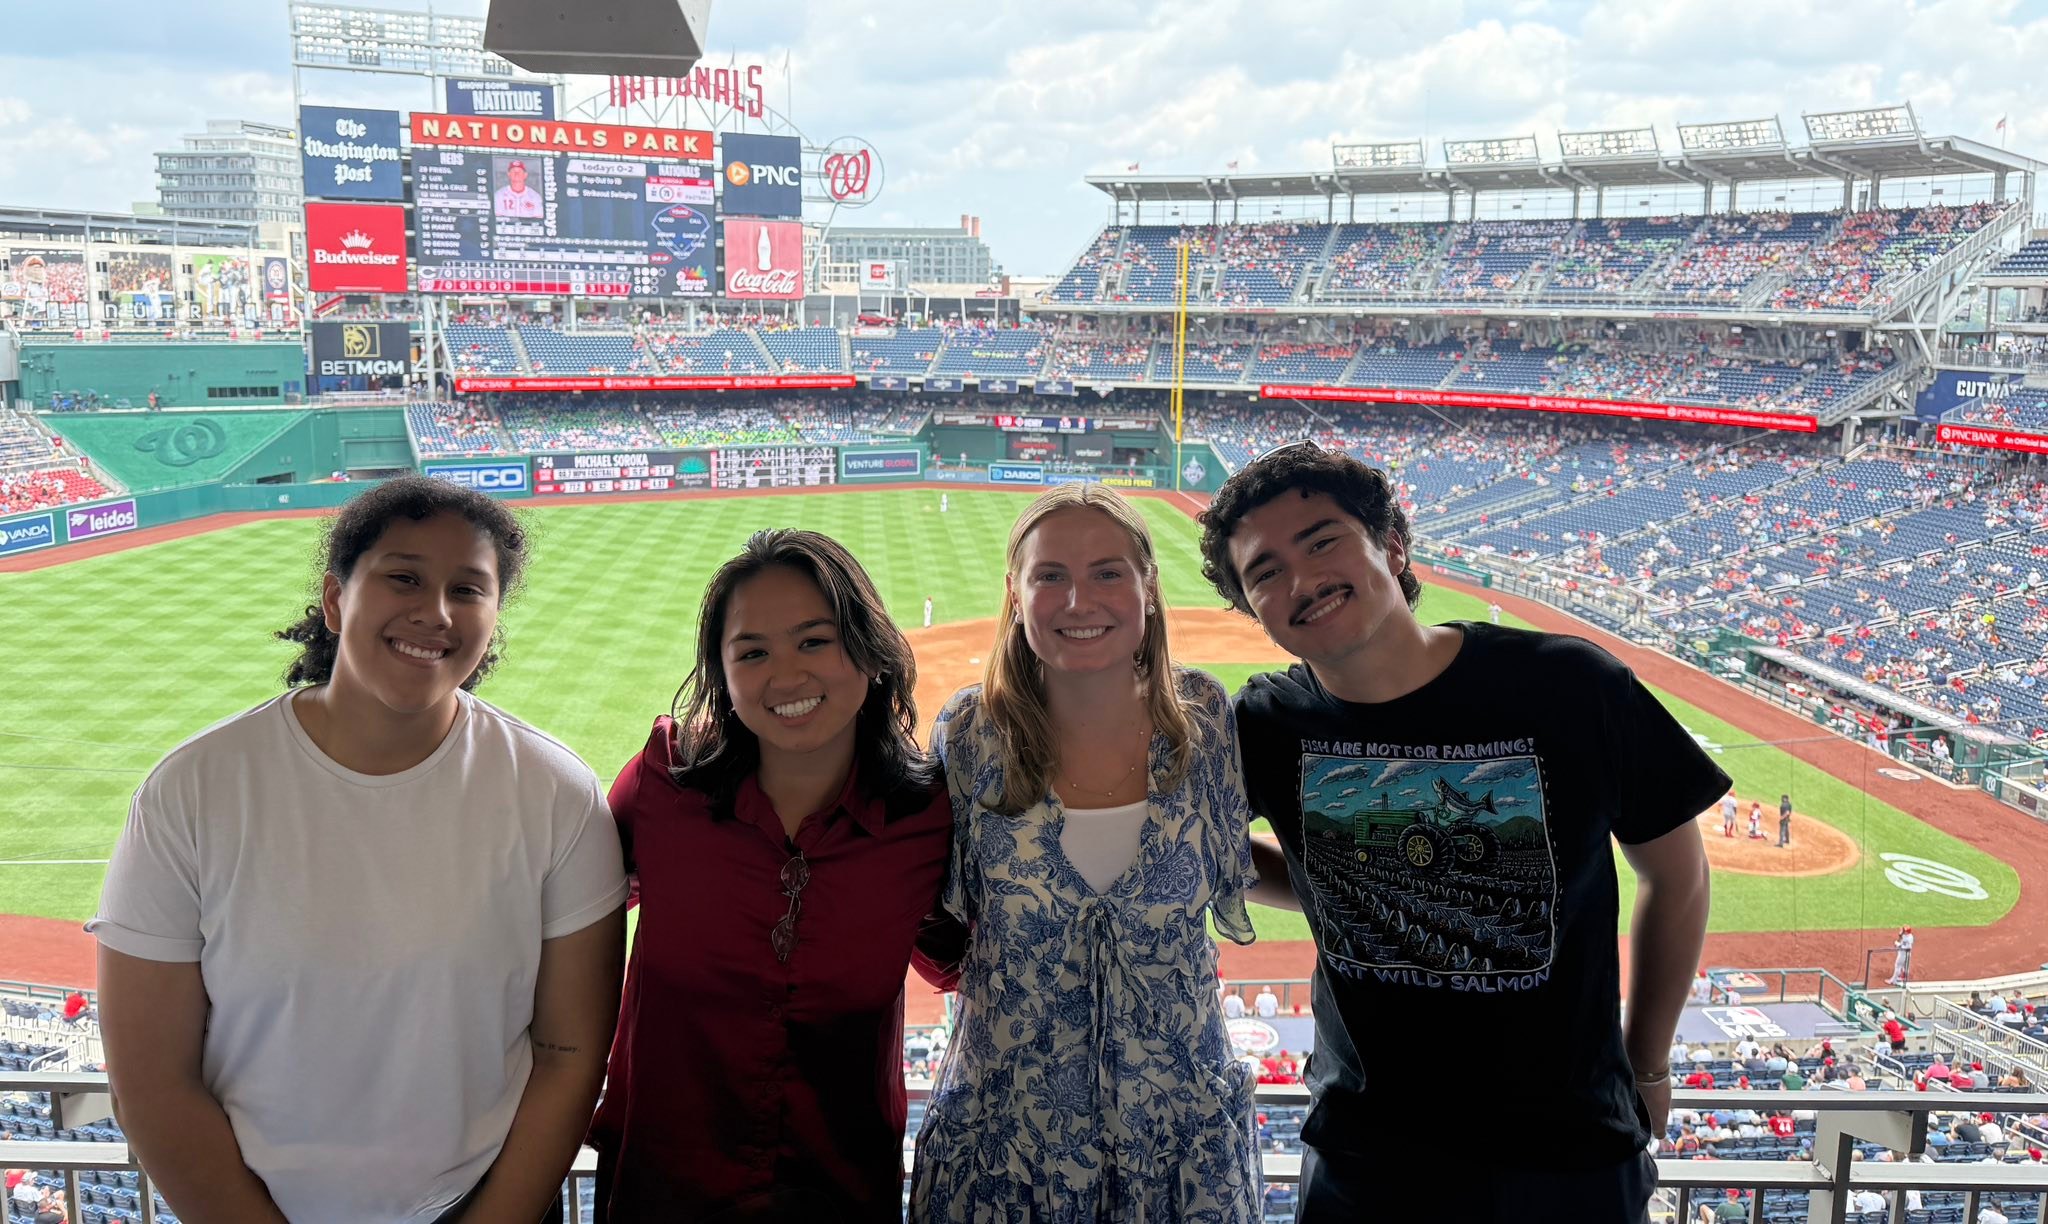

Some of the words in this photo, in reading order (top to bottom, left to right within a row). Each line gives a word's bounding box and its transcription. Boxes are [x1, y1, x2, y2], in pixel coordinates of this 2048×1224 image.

[471, 90, 543, 112] NATITUDE
[335, 118, 367, 139] The
[422, 119, 608, 147] NATIONALS
[623, 131, 699, 153] PARK
[304, 135, 400, 162] Washington
[334, 164, 373, 185] Post
[582, 163, 614, 173] today:
[753, 165, 800, 186] PNC
[504, 199, 514, 210] 12
[313, 249, 400, 265] Budweiser
[321, 360, 405, 375] BETMGM
[575, 455, 612, 468] MICHAEL
[613, 454, 648, 466] SOROKA
[1075, 449, 1103, 457] verizon
[847, 459, 883, 469] VENTURE
[885, 458, 915, 468] GLOBAL
[1004, 470, 1041, 479] DABOS
[1101, 478, 1133, 486] HERCULES
[1133, 479, 1153, 487] FENCE
[90, 509, 134, 531] leidos
[8, 524, 49, 540] VANDA
[1301, 739, 1330, 753] FISH
[1333, 741, 1362, 756] ARE
[1366, 743, 1401, 757] NOT
[1404, 745, 1438, 759] FOR
[1443, 738, 1535, 759] FARMING!
[1326, 955, 1367, 979] EAT
[1374, 968, 1443, 988] WILD
[1451, 967, 1550, 993] SALMON
[1719, 1023, 1787, 1039] MLB
[1779, 1122, 1792, 1133] 44
